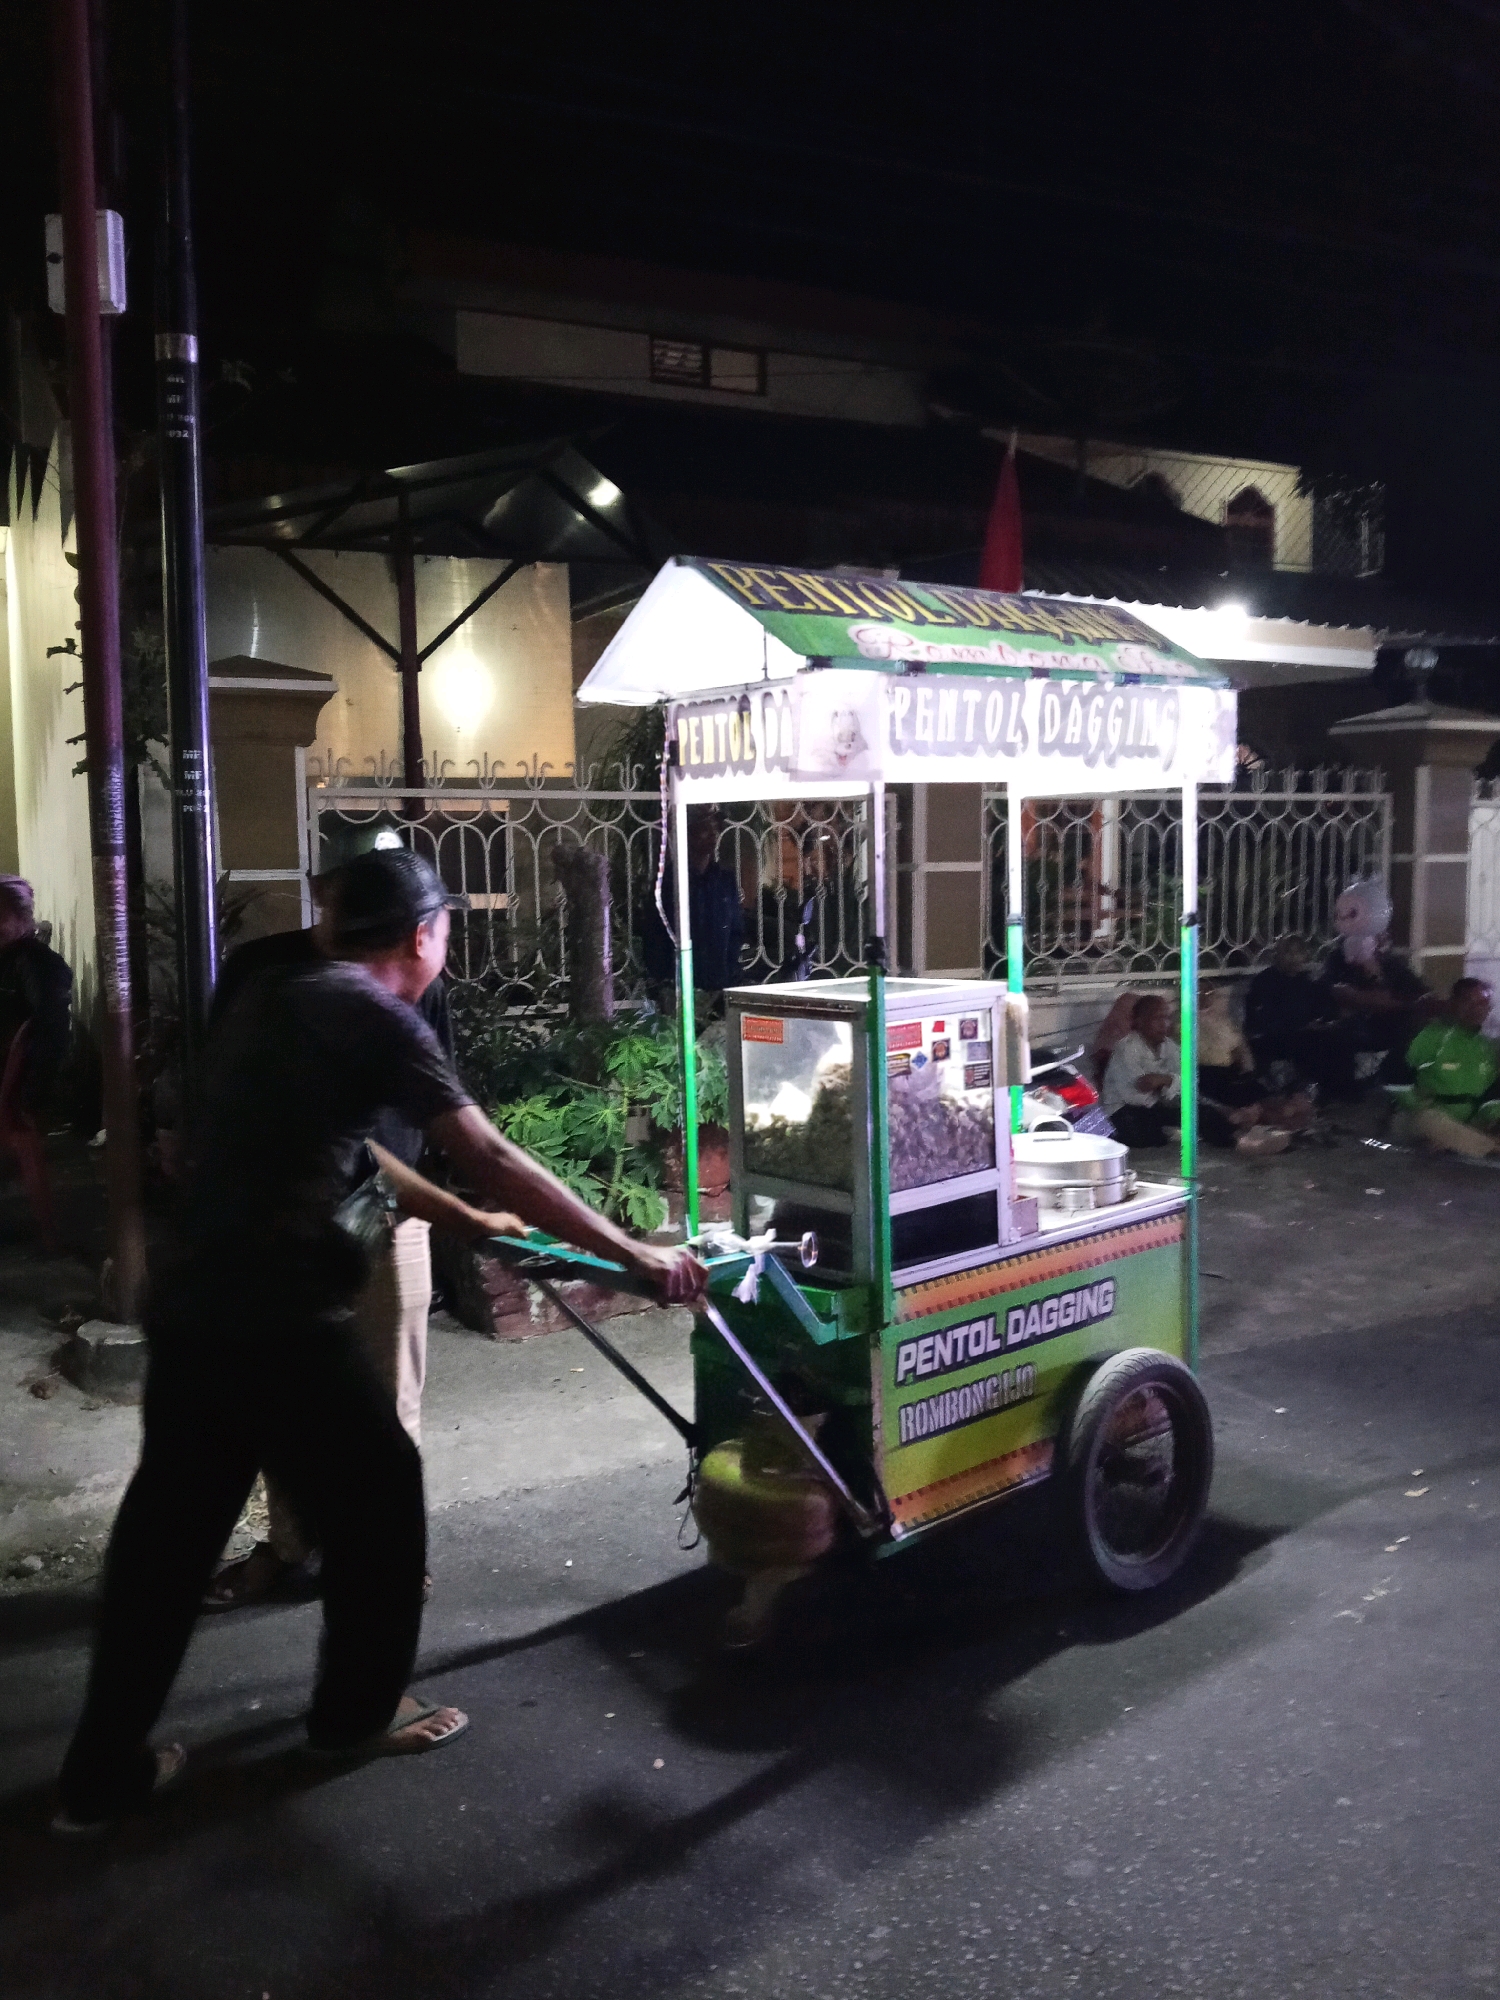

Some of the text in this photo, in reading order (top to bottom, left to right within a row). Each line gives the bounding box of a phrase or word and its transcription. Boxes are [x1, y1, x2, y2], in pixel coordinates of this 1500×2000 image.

[708, 563, 1164, 651] PENTOL DAGGING
[677, 711, 756, 766] PENTOL
[893, 687, 1177, 760] PENTOL DAGGING
[897, 1279, 1115, 1385] PENTOL DAGGING
